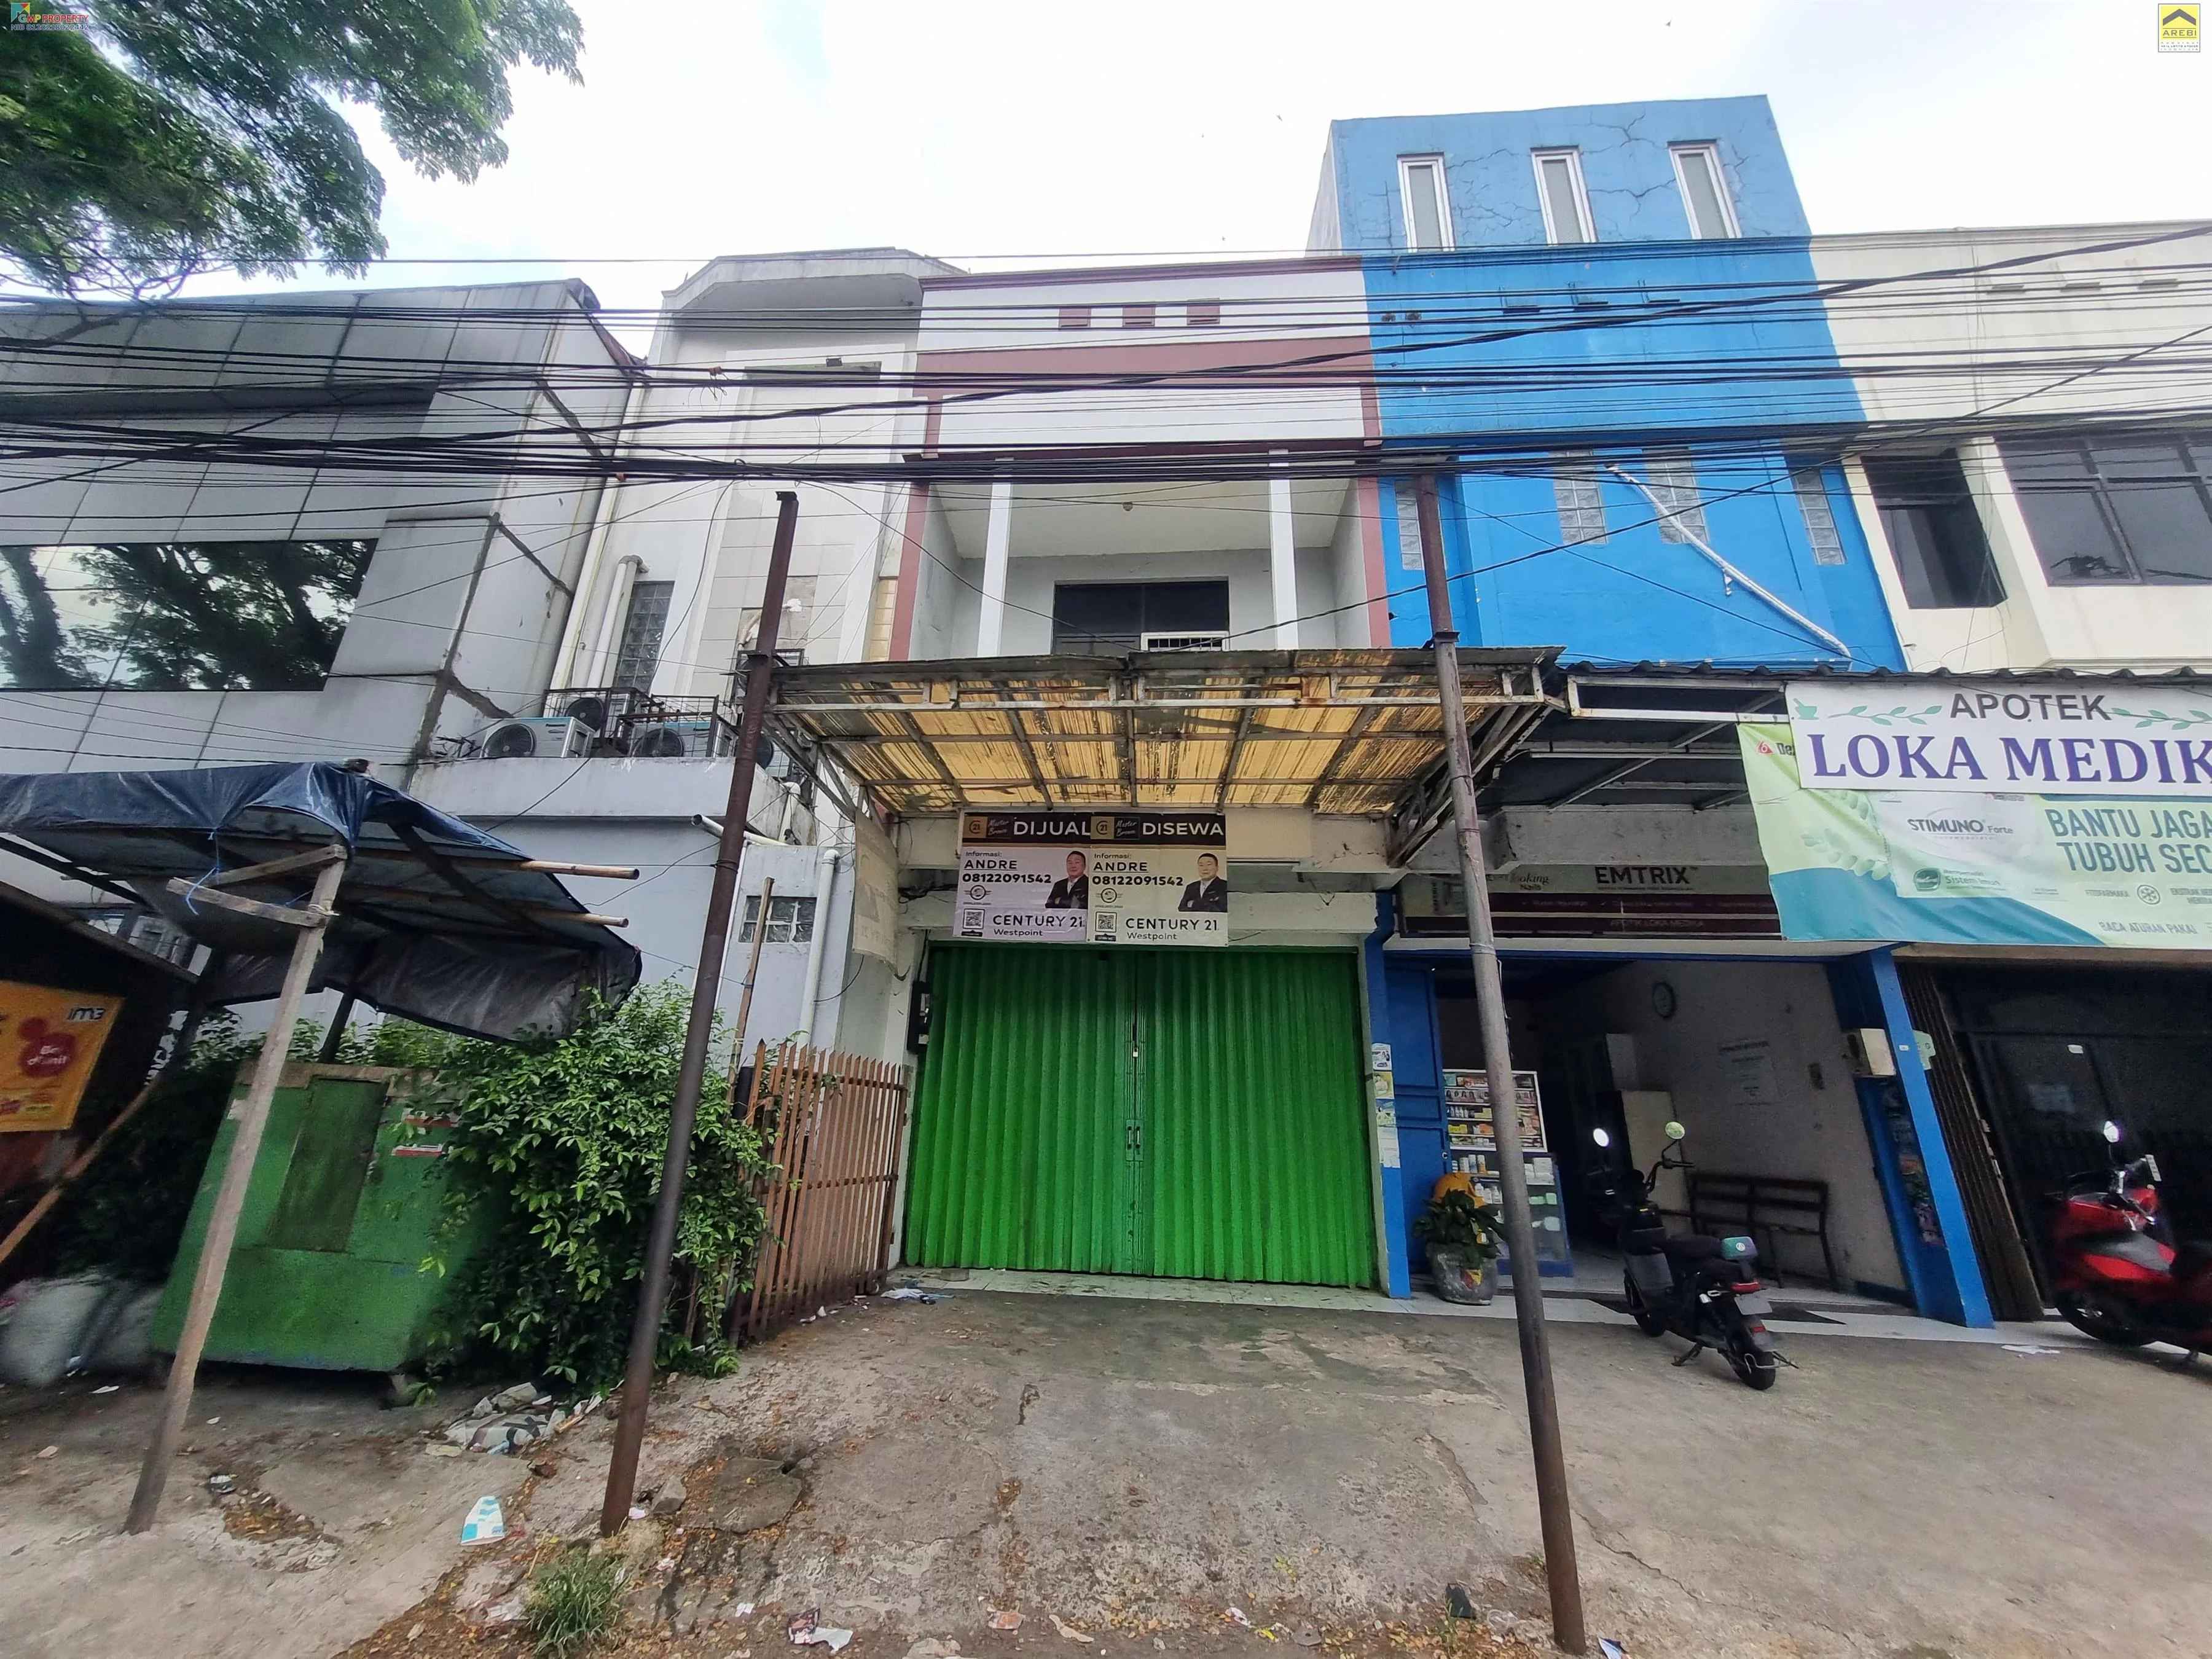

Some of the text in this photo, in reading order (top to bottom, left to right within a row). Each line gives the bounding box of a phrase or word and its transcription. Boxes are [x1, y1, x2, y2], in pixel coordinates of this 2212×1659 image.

[1950, 692, 2112, 721] APOTEK
[1806, 734, 1988, 780] LOKA
[1014, 821, 1091, 836] DIJUAL
[1142, 822, 1224, 836] DISEWA
[1907, 818, 2014, 835] STIMUNO Forte
[2044, 808, 2141, 837] BANTU
[2056, 842, 2156, 873] TUBUH
[964, 860, 1018, 869] ANDRE
[1093, 861, 1148, 871] ANDRE
[962, 873, 1052, 884] 08122091542
[1092, 876, 1183, 886] 08122091542
[1594, 866, 1690, 884] EMTRIX
[992, 915, 1066, 927] CENTURY
[1125, 918, 1200, 930] CENTURY
[994, 928, 1043, 937] Westpoint
[1127, 932, 1178, 941] Westpoint
